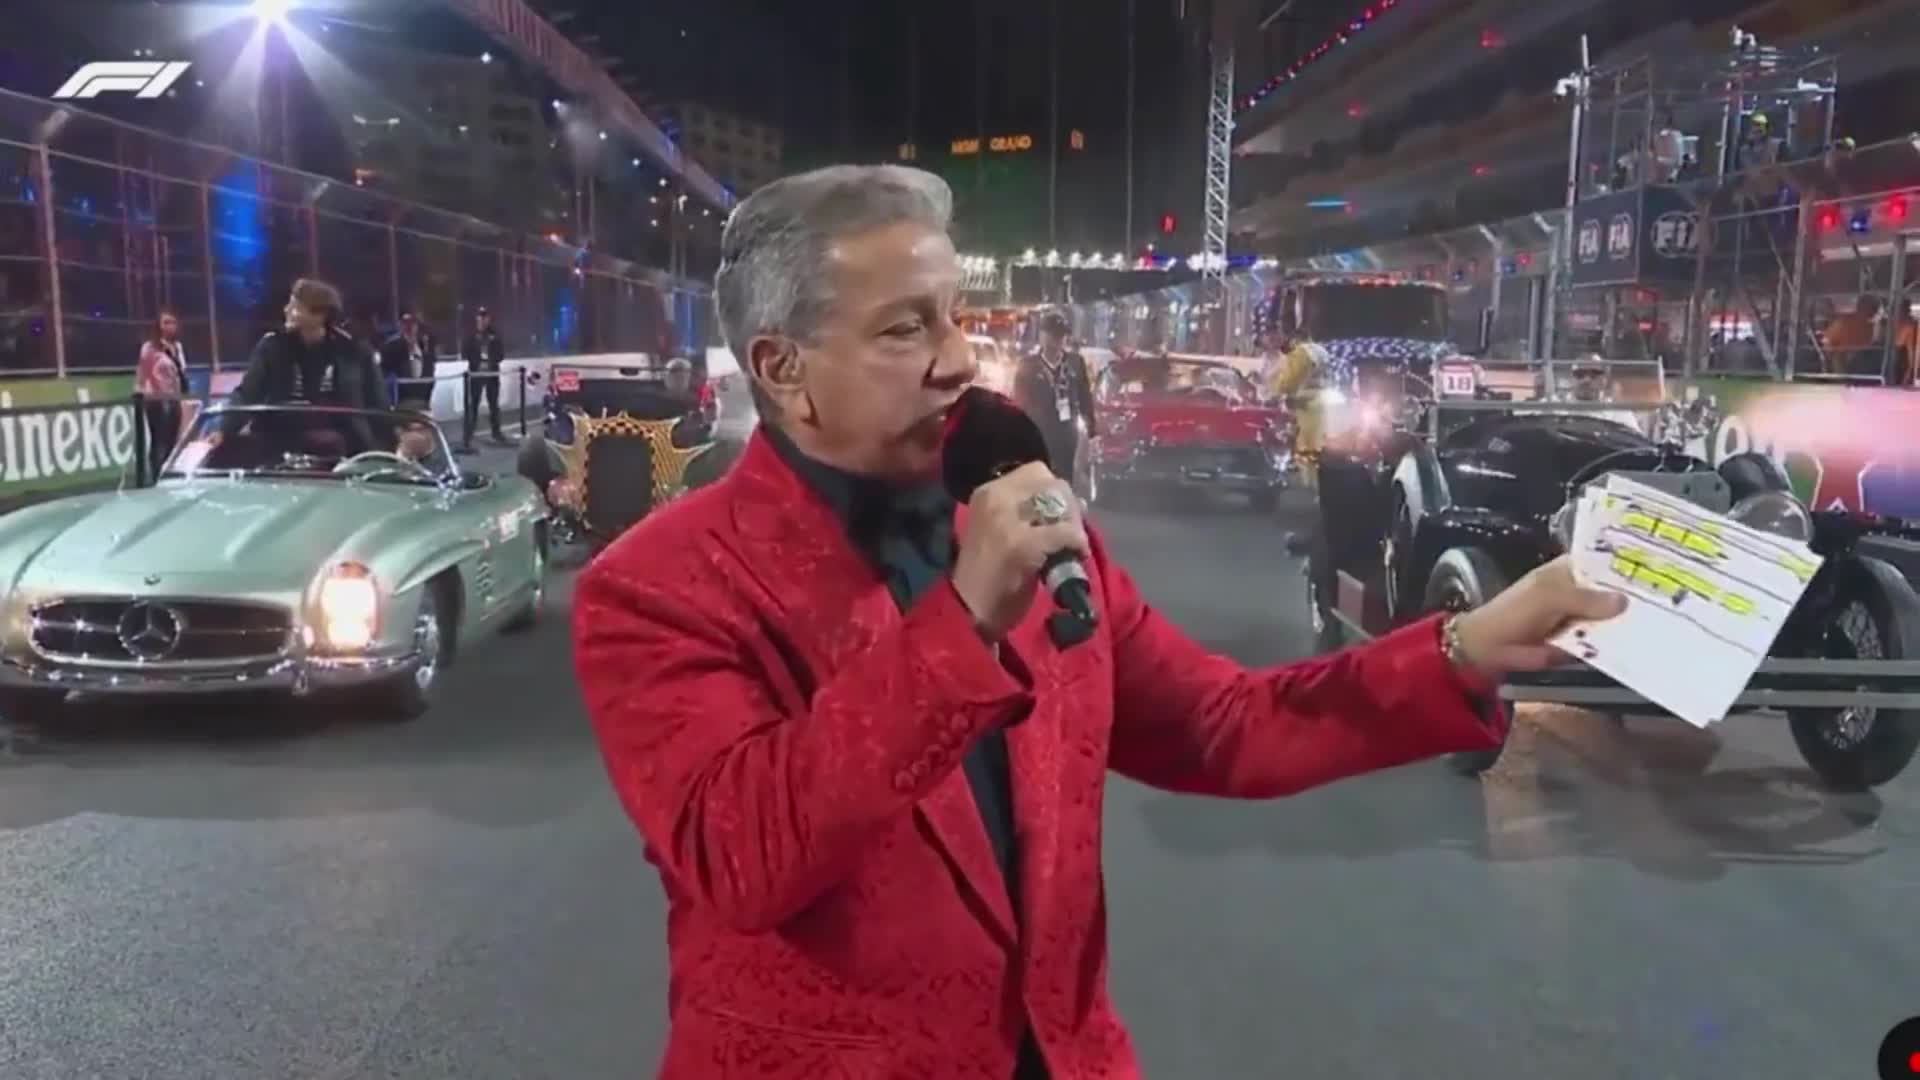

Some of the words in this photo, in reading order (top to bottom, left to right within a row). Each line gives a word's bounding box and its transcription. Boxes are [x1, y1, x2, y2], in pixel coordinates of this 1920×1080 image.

[1579, 228, 1599, 256] FIA
[1608, 224, 1630, 251] FIA
[1447, 376, 1470, 390] 18
[0, 388, 136, 482] ineke
